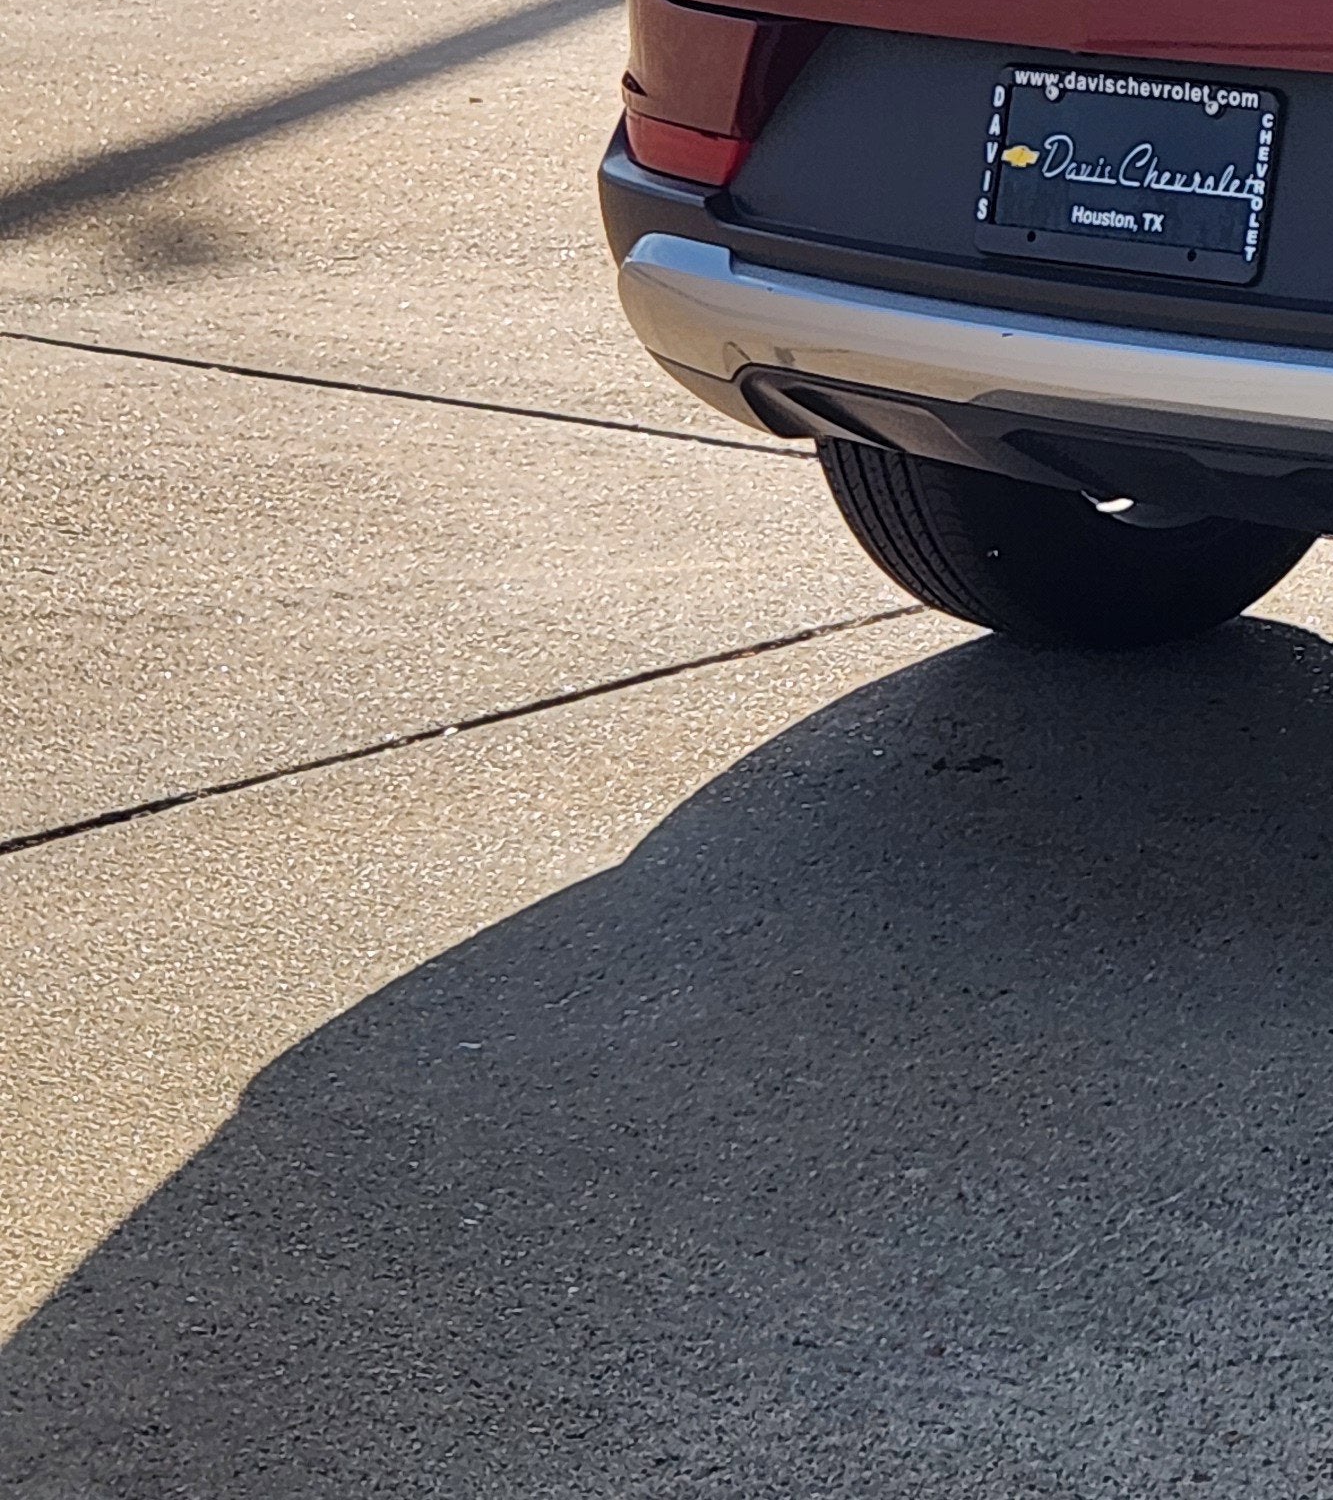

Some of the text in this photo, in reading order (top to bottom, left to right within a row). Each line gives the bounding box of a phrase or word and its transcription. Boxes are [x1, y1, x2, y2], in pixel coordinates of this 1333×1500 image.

[1014, 69, 1260, 109] www.davischevroletcom
[975, 84, 1006, 221] DAVIS
[1042, 133, 1117, 185] Davis
[1118, 142, 1256, 201] Chevrolet
[1243, 112, 1275, 263] CHEVROLET
[1070, 204, 1165, 233] Houston, TX
